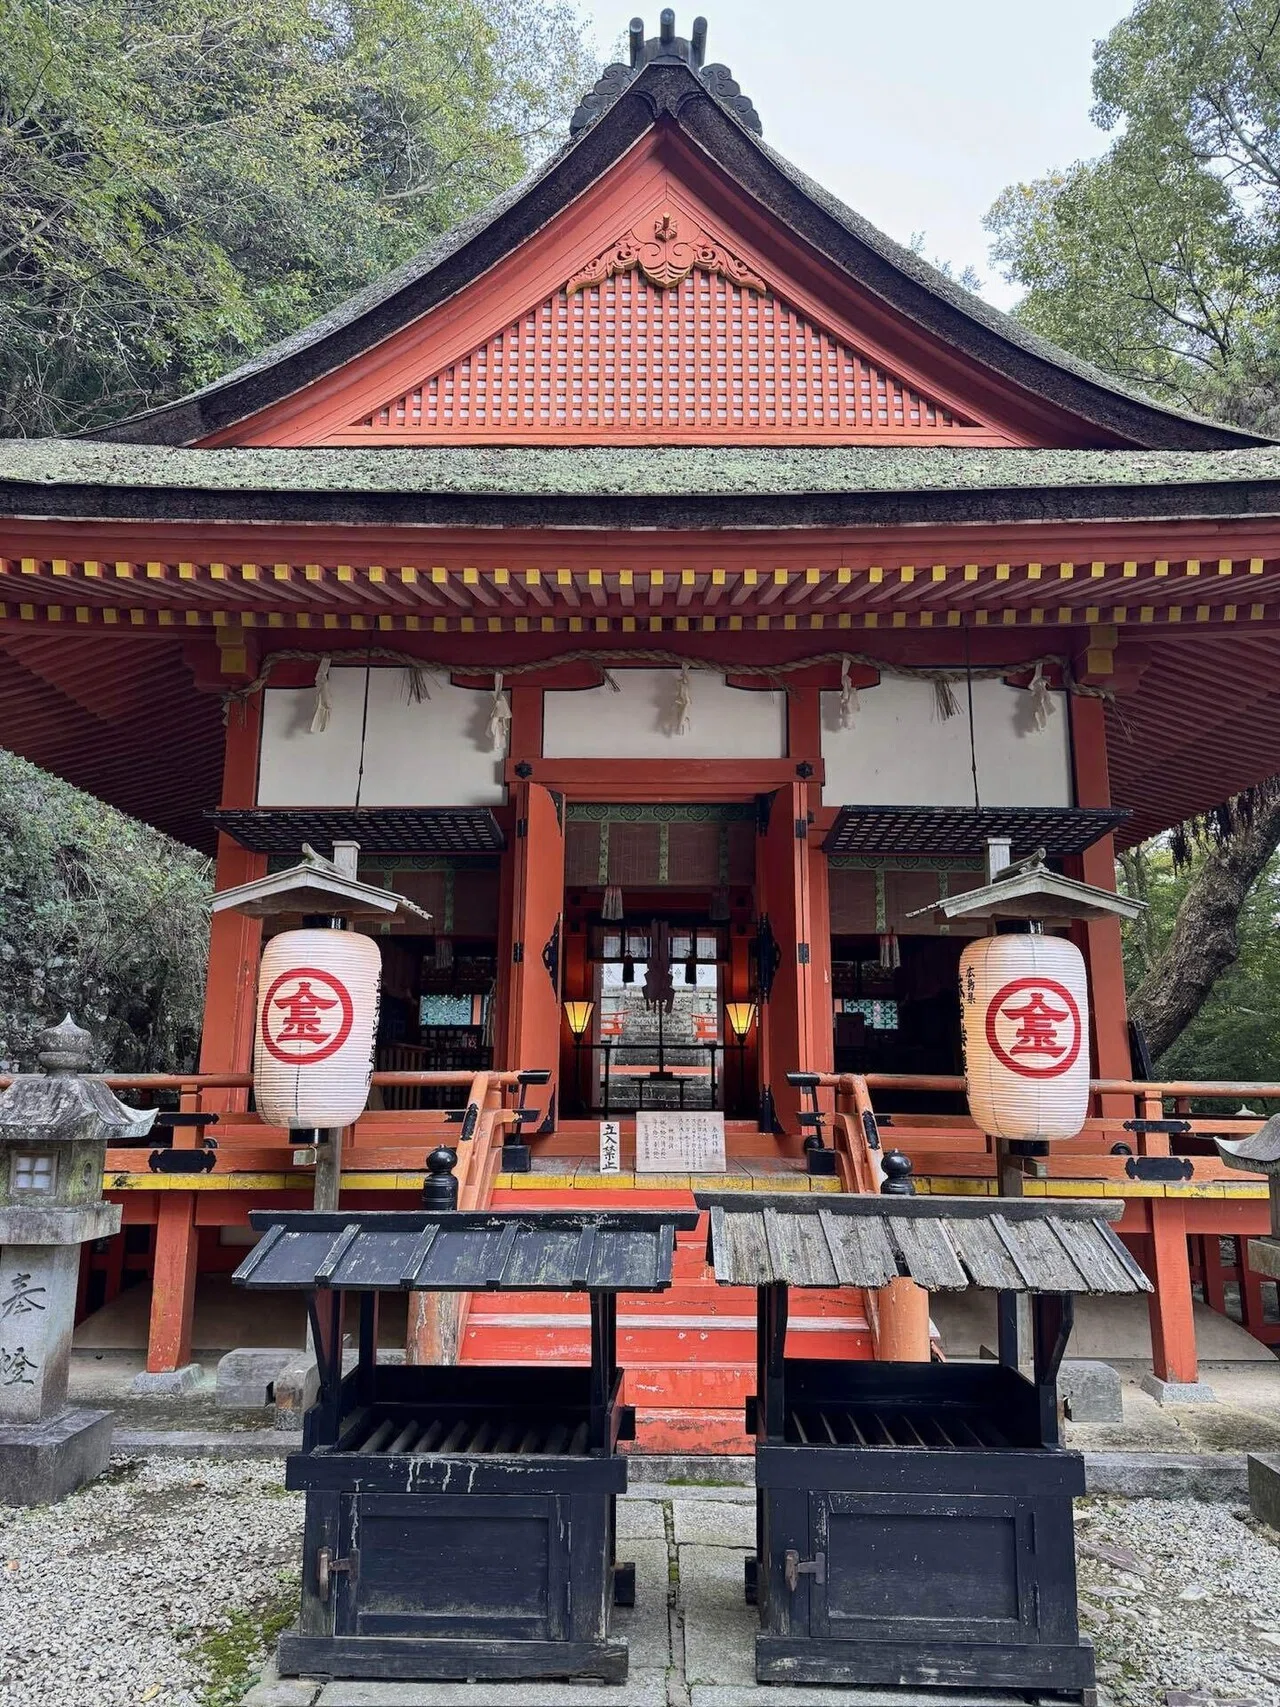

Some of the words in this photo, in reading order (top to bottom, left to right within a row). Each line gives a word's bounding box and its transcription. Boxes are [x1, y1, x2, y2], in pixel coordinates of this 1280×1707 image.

[274, 981, 339, 1044] 金
[1001, 992, 1069, 1058] 金
[602, 1124, 617, 1170] 立入禁止
